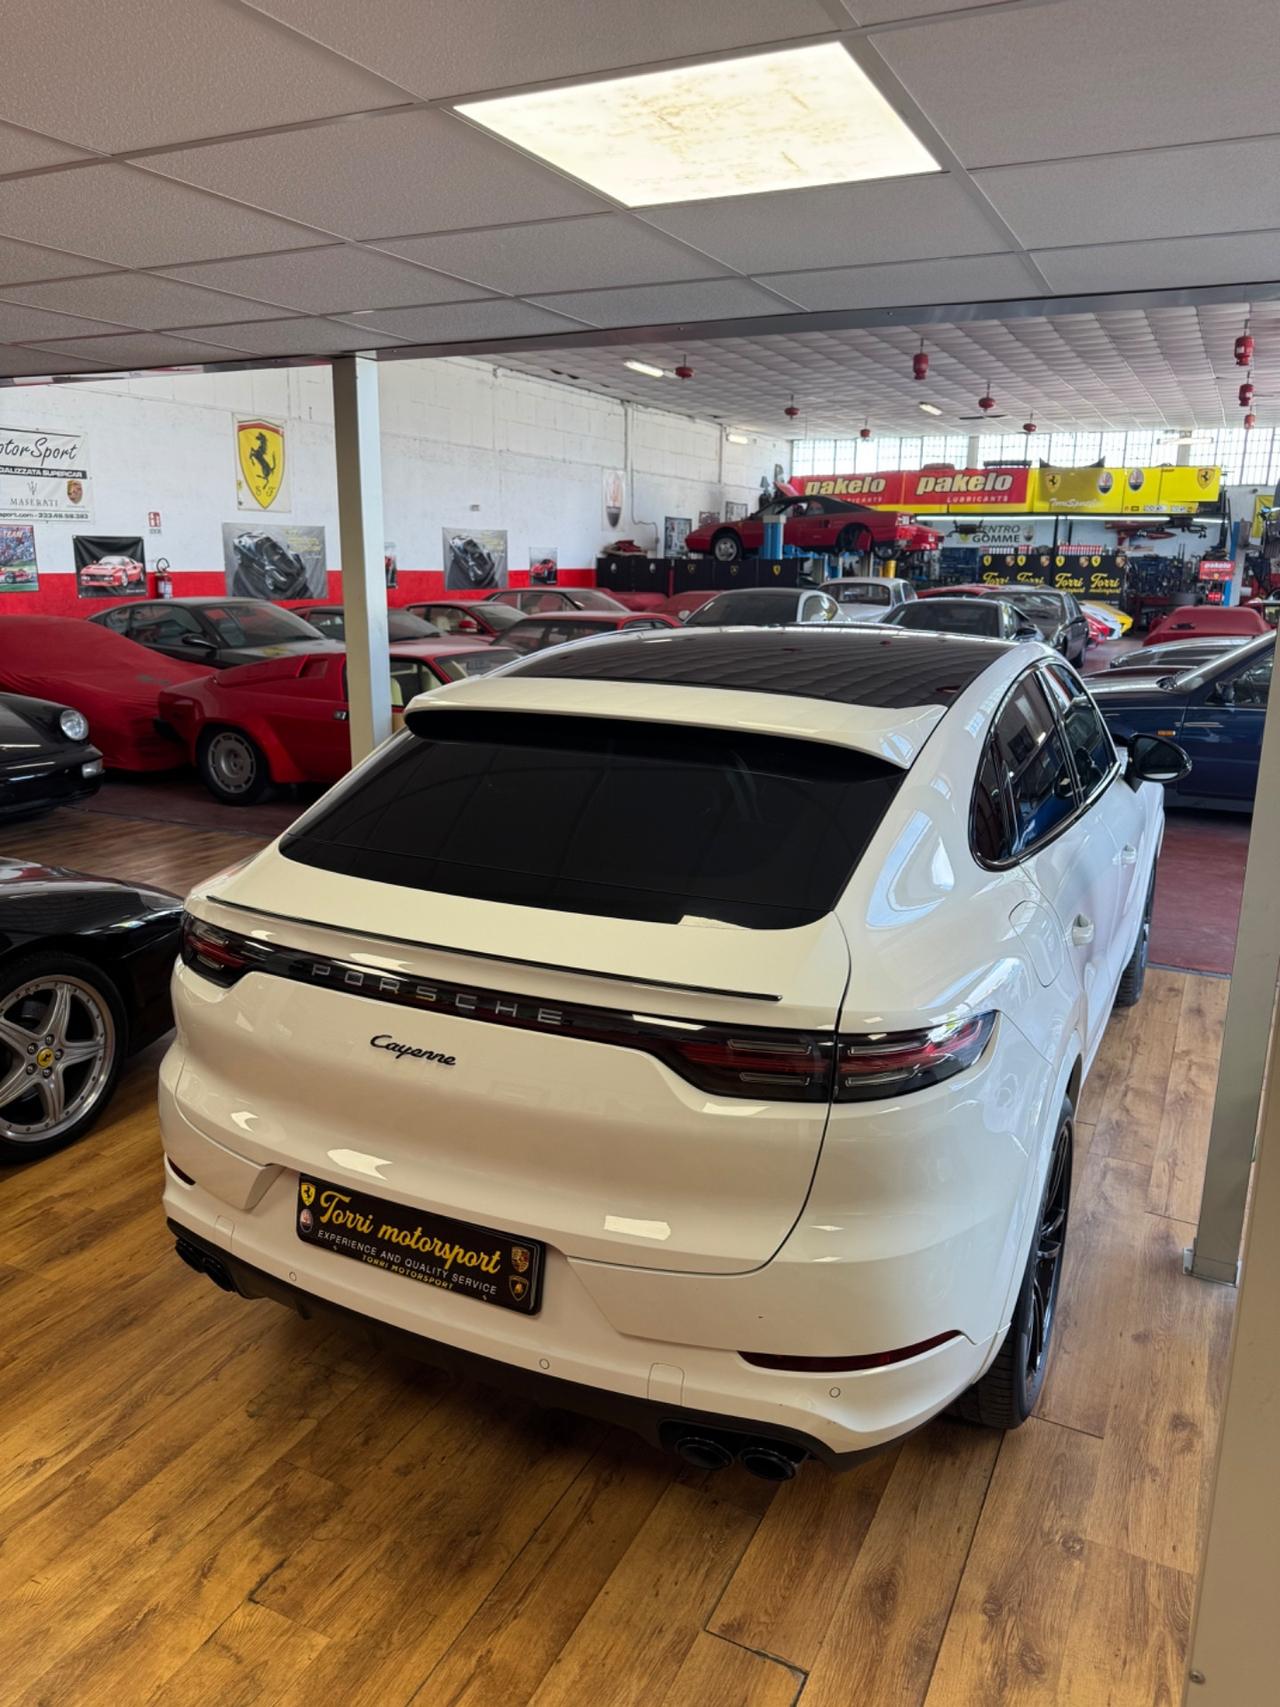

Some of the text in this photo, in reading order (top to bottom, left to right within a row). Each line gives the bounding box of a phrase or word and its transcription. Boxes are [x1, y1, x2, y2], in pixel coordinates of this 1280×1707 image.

[804, 476, 887, 496] pakelo
[915, 472, 1013, 495] pakelo
[10, 498, 58, 507] MASERATI
[946, 495, 1010, 503] LUBRICANTS
[972, 534, 1020, 543] GOMME
[1055, 572, 1084, 588] Torri
[1090, 573, 1120, 588] Torri
[311, 963, 563, 1025] PORSCHE
[370, 1034, 456, 1066] Cayenne
[320, 1190, 501, 1274] Torri motorsport
[317, 1229, 497, 1295] EXPERIENCE AND QUALITY SERVICE
[362, 1254, 453, 1290] TORRI MOTORSPORT
